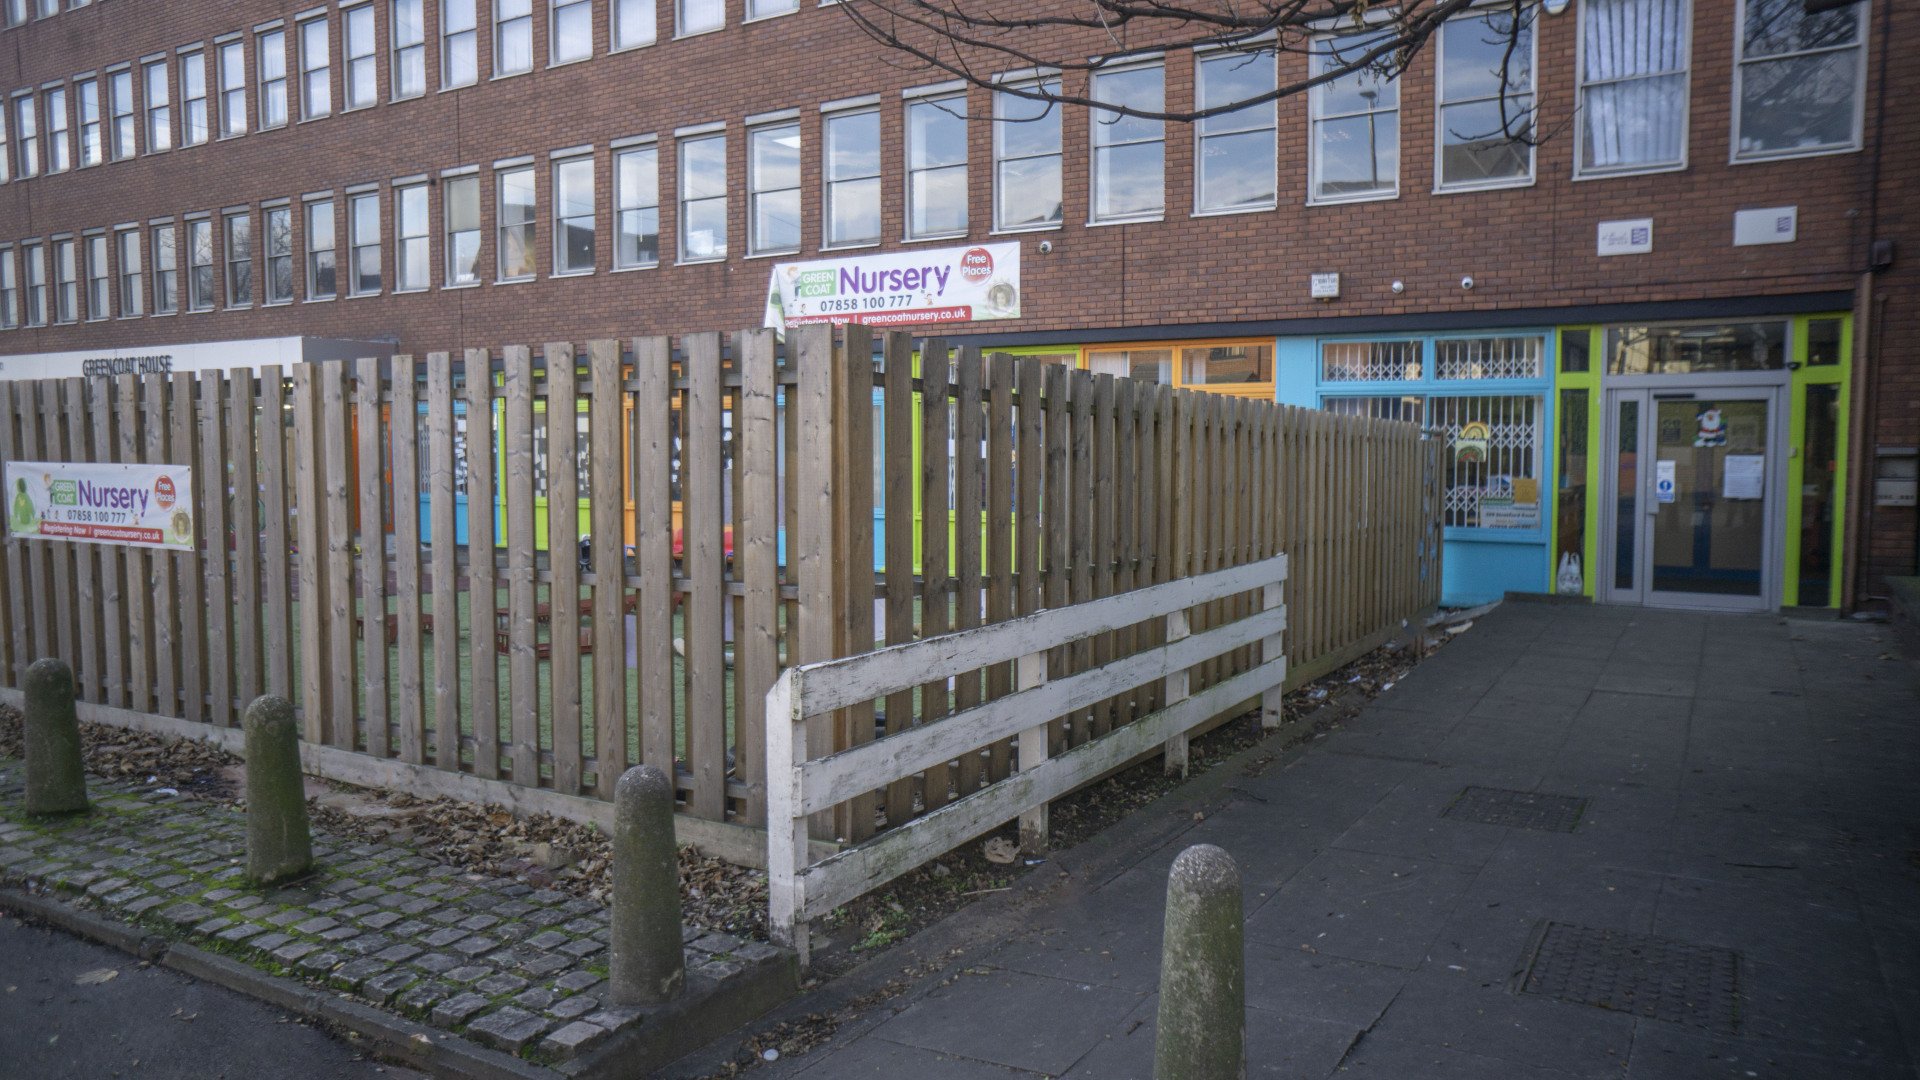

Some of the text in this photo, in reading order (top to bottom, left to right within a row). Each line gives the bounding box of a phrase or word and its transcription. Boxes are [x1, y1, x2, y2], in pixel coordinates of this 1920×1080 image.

[966, 253, 987, 265] Free
[962, 264, 992, 277] Places
[802, 271, 835, 284] GREEN
[840, 264, 951, 297] Nursery
[805, 283, 831, 296] COAT
[820, 295, 913, 312] 07858 100 777
[831, 316, 850, 325] Now
[862, 309, 966, 325] greencoatnursery.co.uk
[82, 355, 173, 377] GREENCOAT HOUSE
[54, 480, 76, 492] GREEN
[157, 481, 172, 491] Free
[57, 492, 75, 504] COAT
[78, 480, 149, 517] Nursery
[155, 491, 176, 503] Places
[67, 510, 126, 524] 07858 100 777
